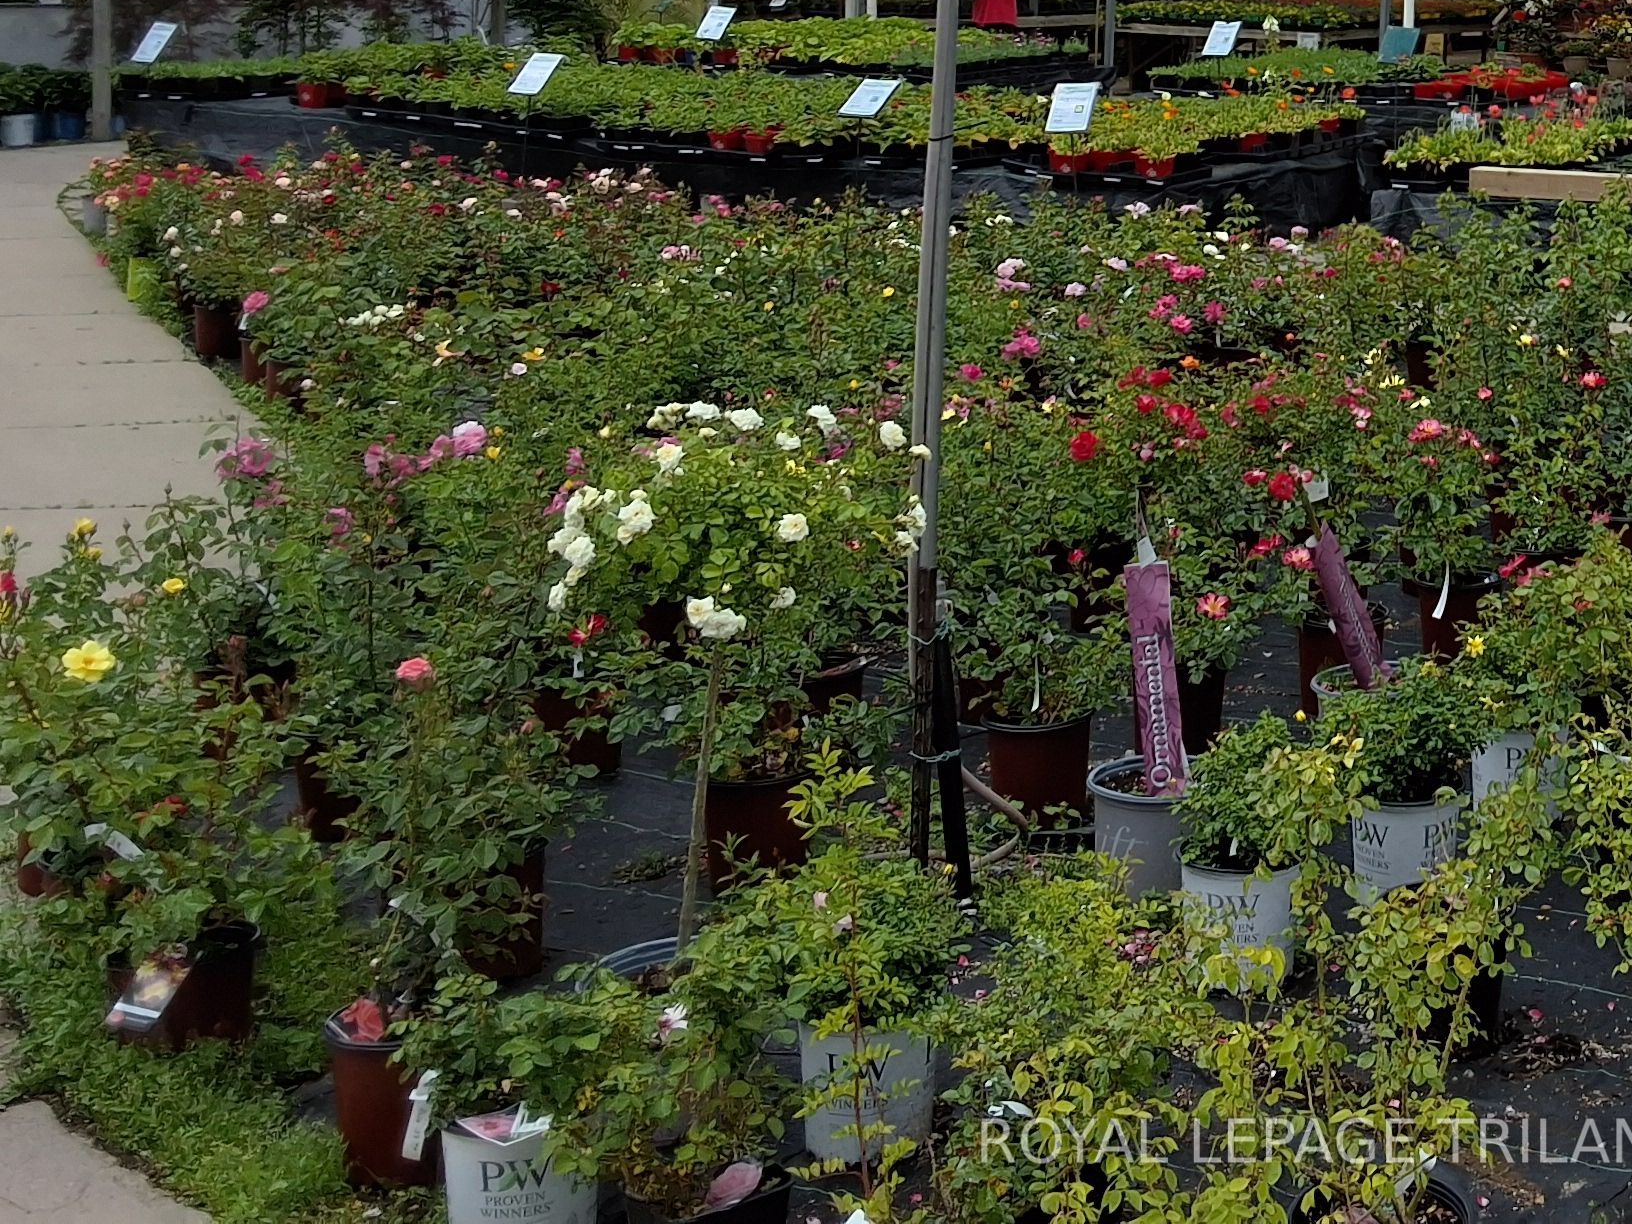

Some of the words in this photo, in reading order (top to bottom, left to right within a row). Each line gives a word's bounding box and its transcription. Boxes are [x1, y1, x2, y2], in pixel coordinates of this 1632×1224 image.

[1136, 632, 1172, 788] Ornamental
[478, 1150, 556, 1193] PW
[481, 1201, 552, 1219] WINNERS
[485, 1191, 546, 1207] PROVEN
